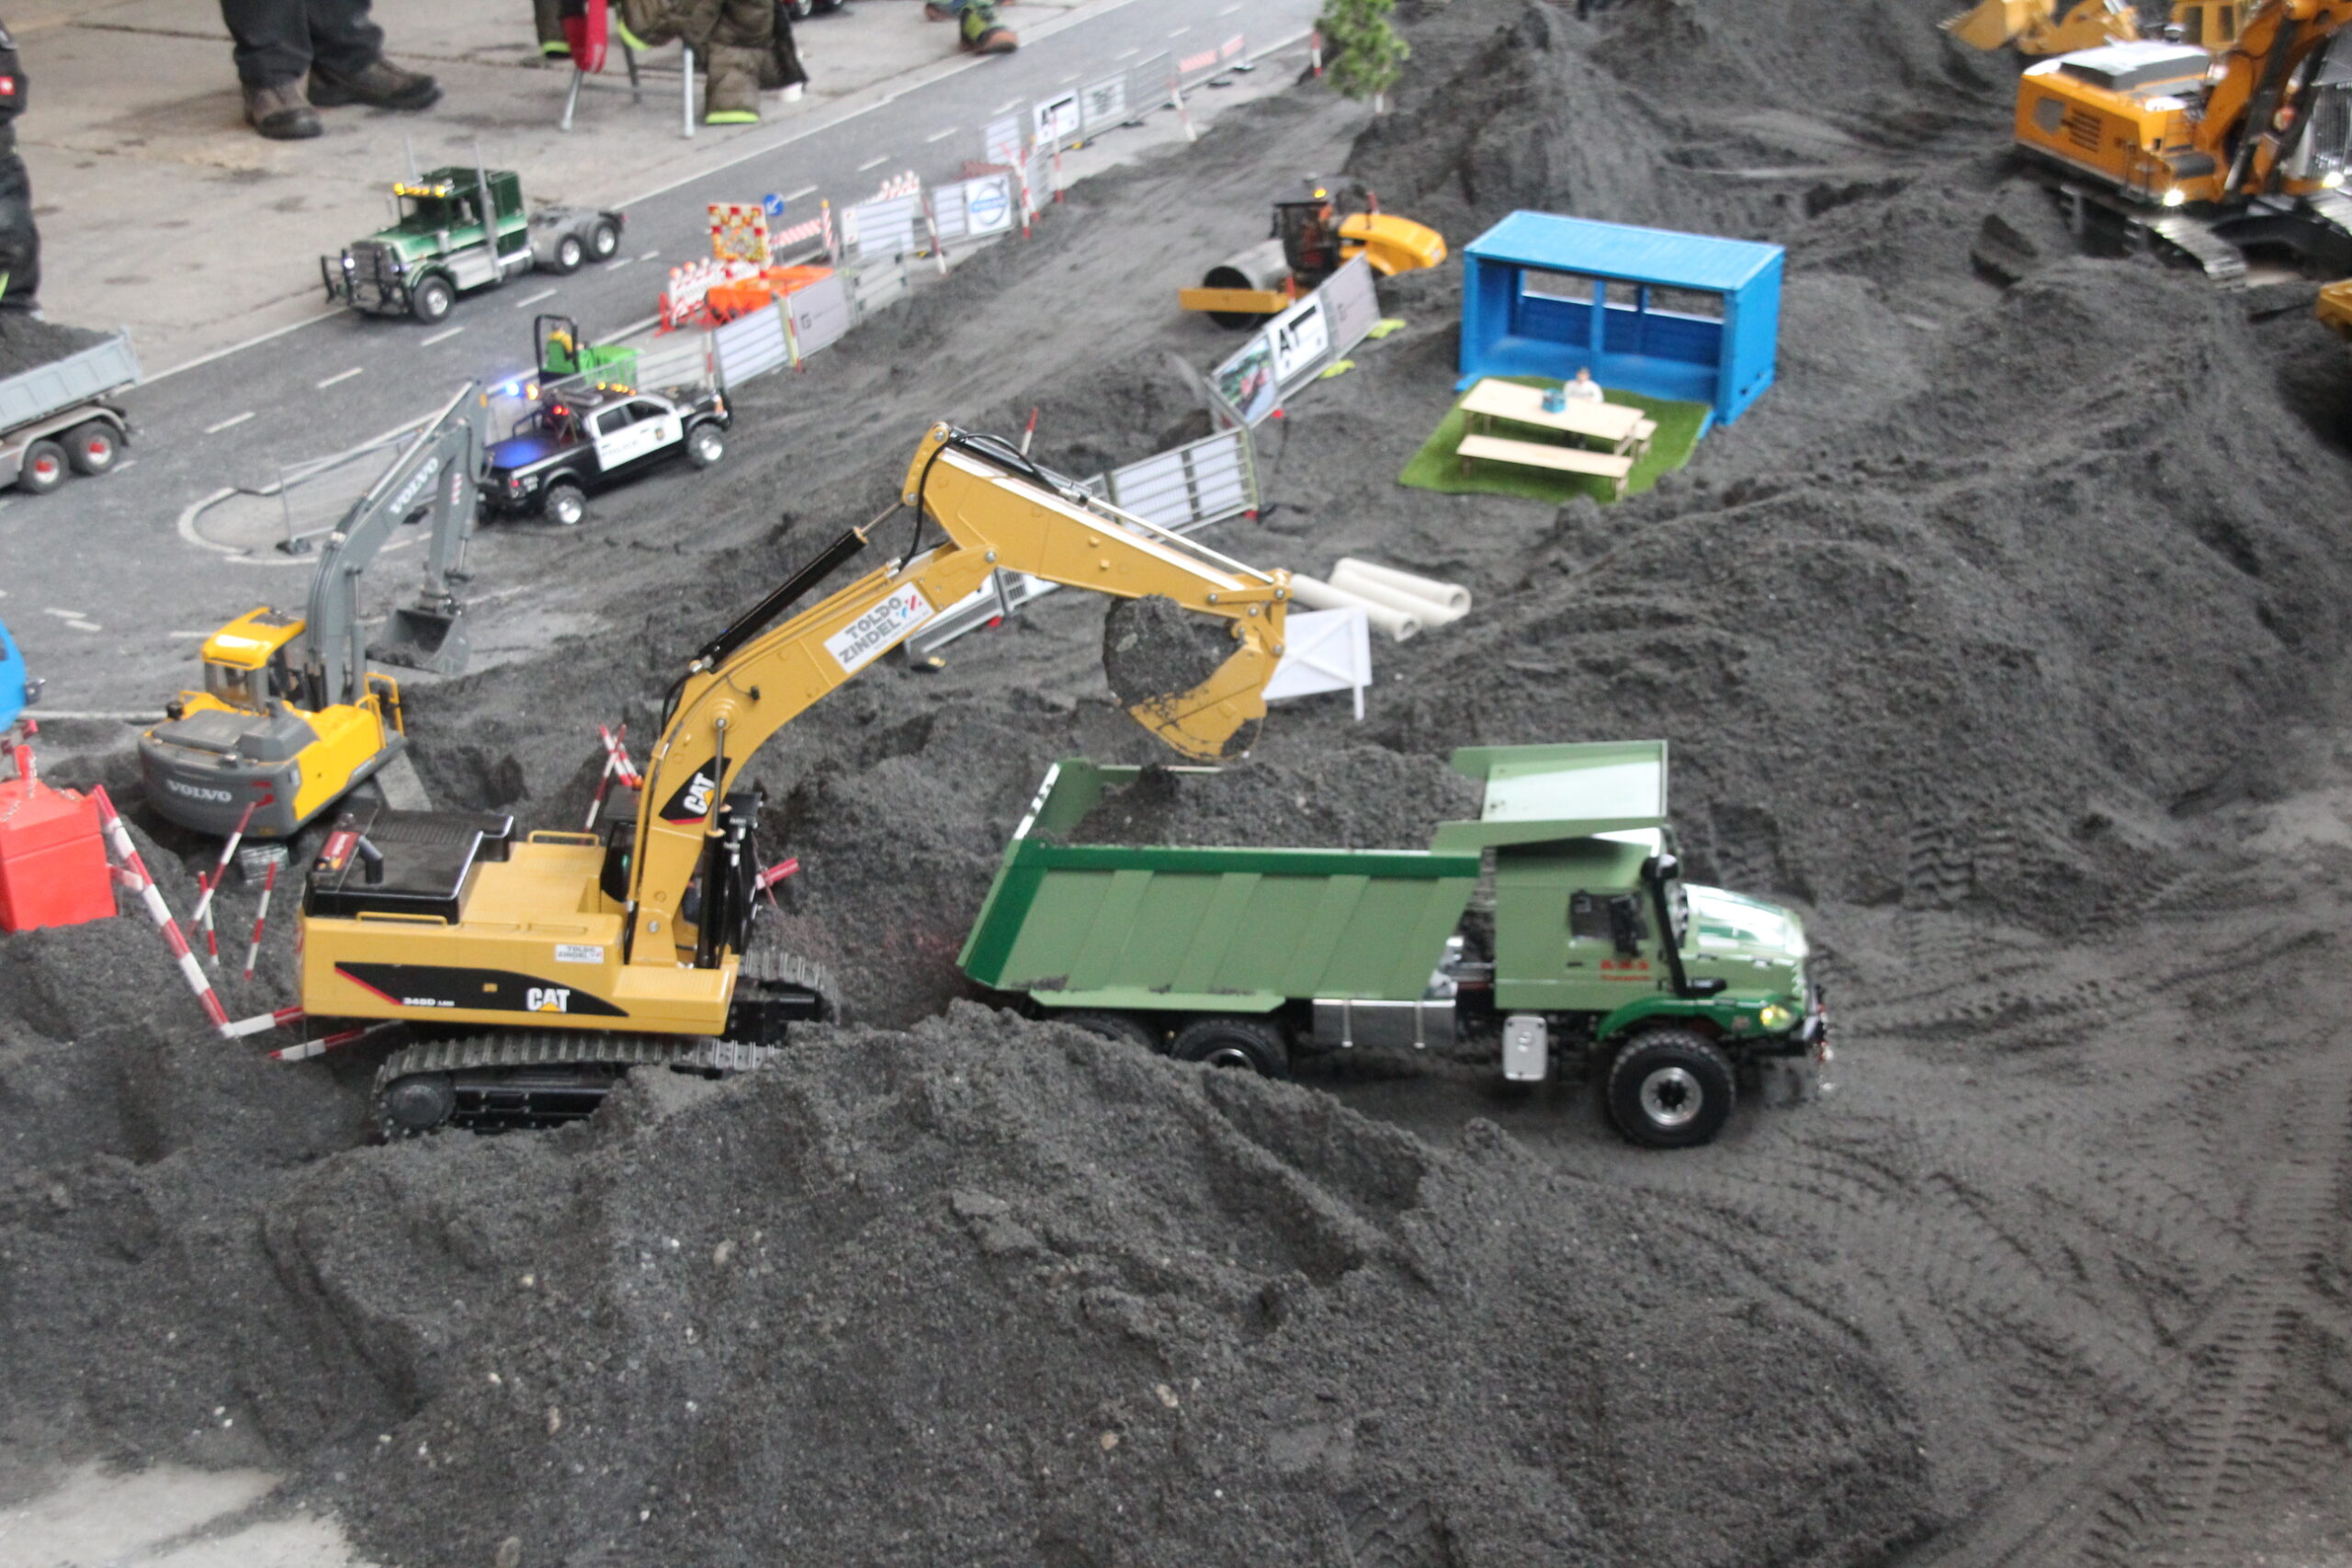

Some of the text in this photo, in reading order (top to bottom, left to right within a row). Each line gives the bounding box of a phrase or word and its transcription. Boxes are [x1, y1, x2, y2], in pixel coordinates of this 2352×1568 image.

[390, 457, 438, 513] VOLVO
[844, 597, 902, 639] TOLDO
[838, 618, 902, 663] ZINDEL
[166, 778, 232, 803] VOLVO
[683, 772, 715, 815] CAT
[526, 987, 571, 1012] CAT
